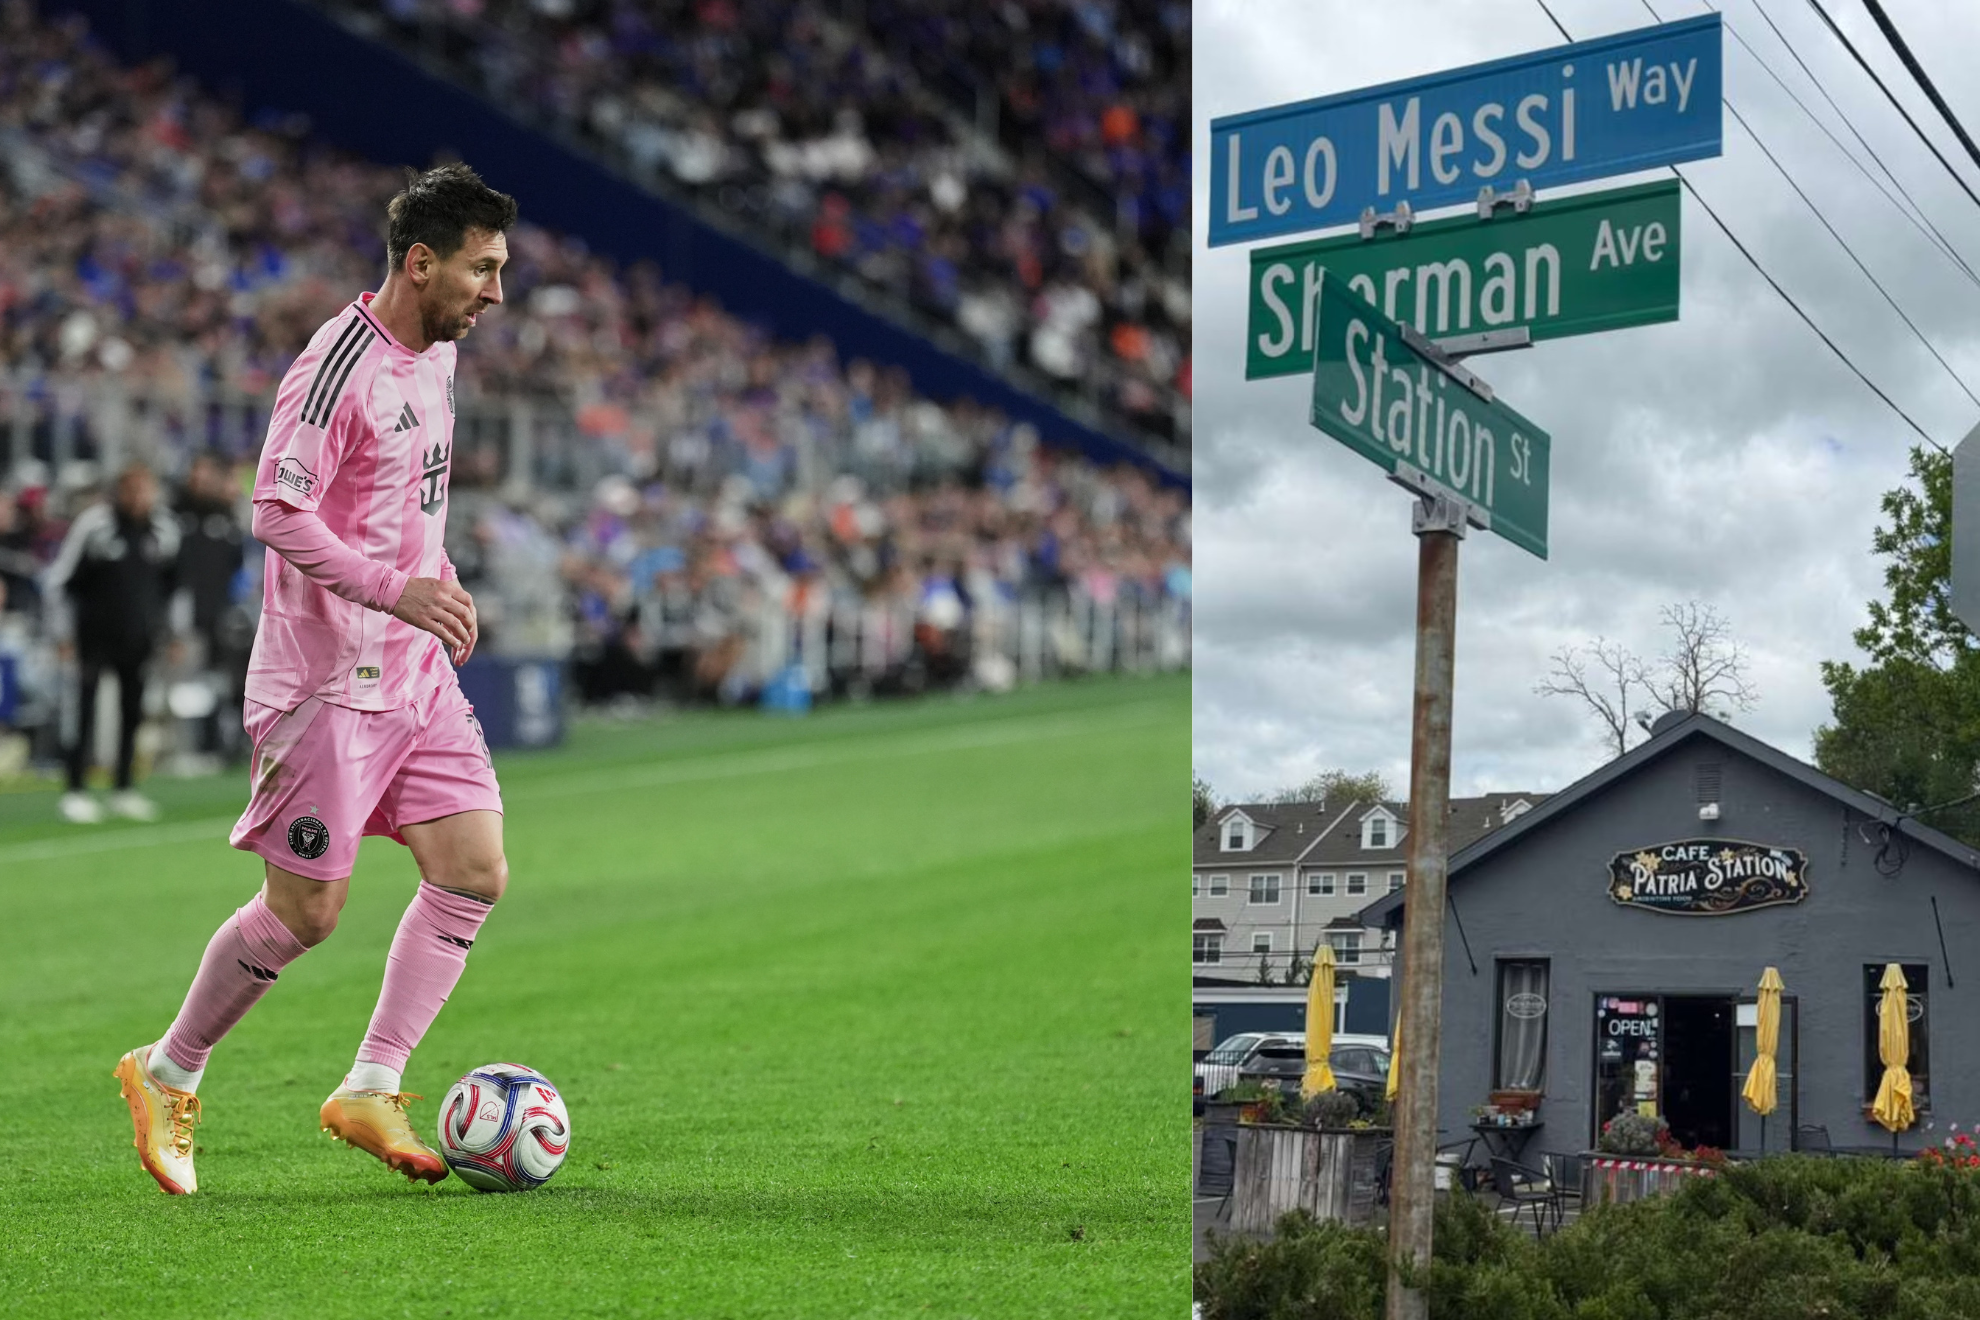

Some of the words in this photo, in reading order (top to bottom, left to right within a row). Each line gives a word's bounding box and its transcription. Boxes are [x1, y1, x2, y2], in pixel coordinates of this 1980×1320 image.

[1226, 133, 1338, 224] Leo
[1377, 64, 1576, 196] Messi
[1606, 56, 1698, 113] Way
[1590, 219, 1668, 272] Ave
[1340, 319, 1496, 509] Station
[1509, 431, 1532, 487] St
[1630, 862, 1698, 896] PATRIA
[1704, 855, 1789, 890] STATION
[1661, 845, 1710, 861] CAFE
[1608, 1019, 1650, 1036] OPEN
